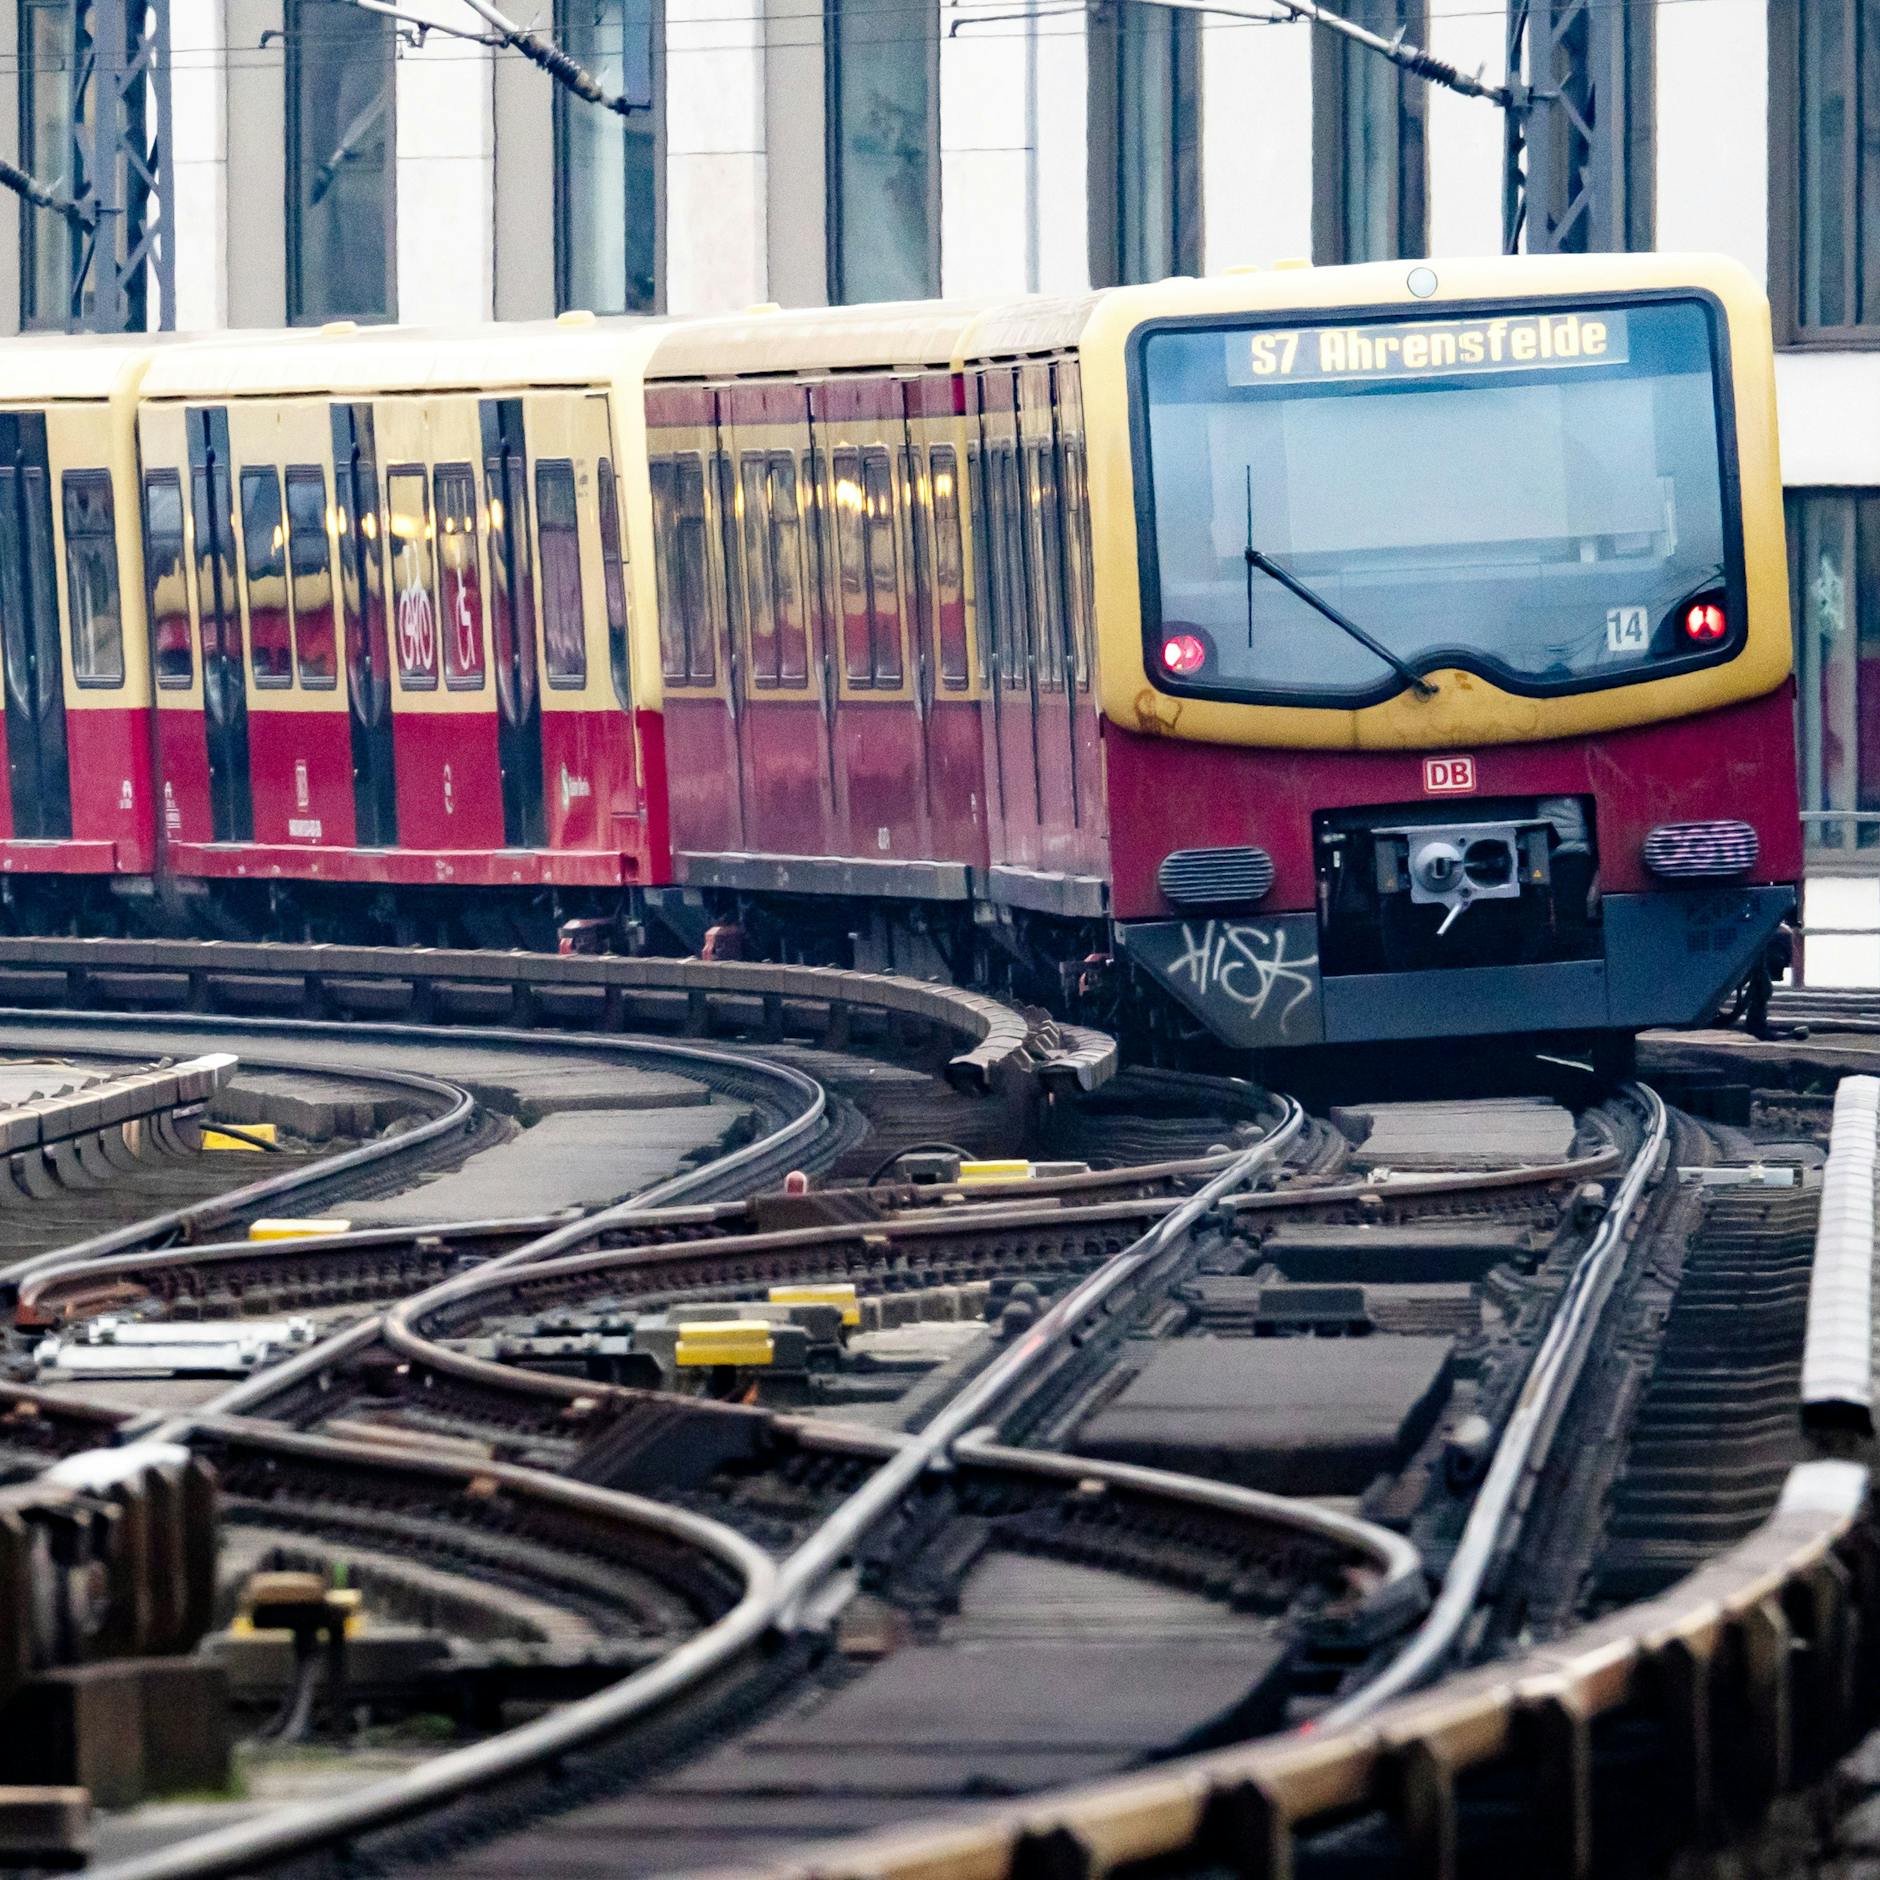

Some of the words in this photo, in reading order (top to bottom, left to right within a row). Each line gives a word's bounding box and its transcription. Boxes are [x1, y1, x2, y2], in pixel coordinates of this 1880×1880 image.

[1251, 333, 1299, 375] S7
[1319, 316, 1607, 372] Ahrensfelde
[1608, 611, 1642, 644] 14
[1430, 761, 1469, 786] DB
